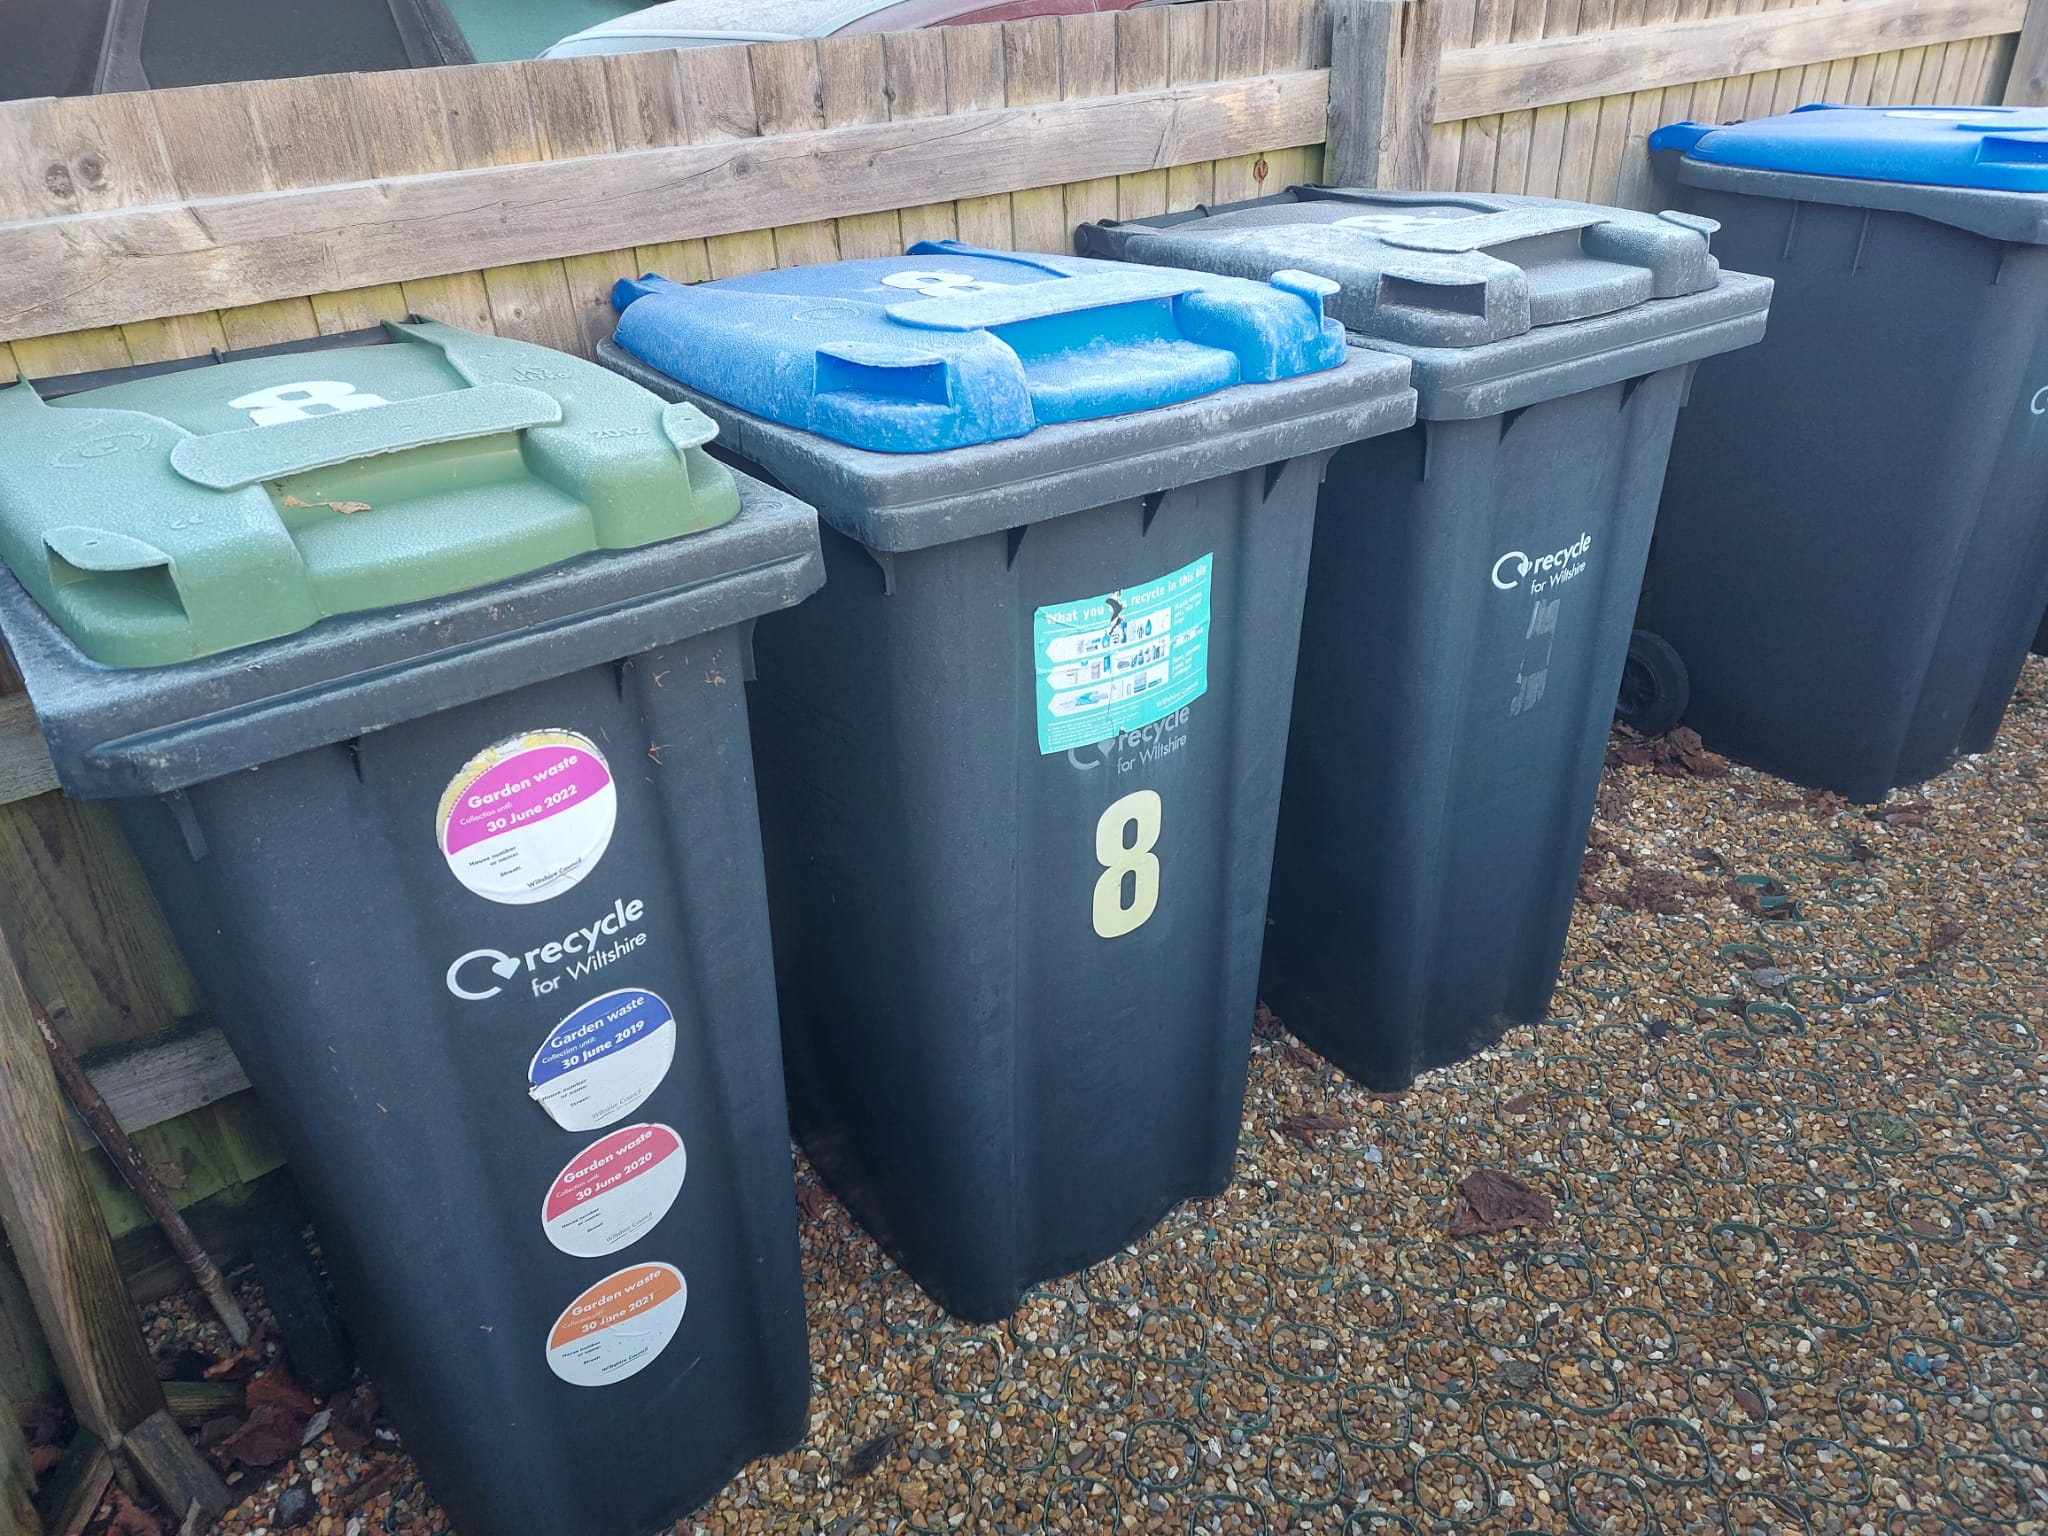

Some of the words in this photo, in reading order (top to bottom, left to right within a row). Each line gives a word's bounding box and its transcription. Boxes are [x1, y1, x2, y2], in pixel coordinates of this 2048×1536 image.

[881, 271, 1000, 298] 8
[227, 381, 391, 427] 8
[1533, 532, 1592, 574] recycle
[1045, 610, 1078, 625] What
[1083, 606, 1104, 620] you
[1131, 585, 1165, 606] recycle
[1167, 580, 1176, 592] in
[1178, 572, 1193, 587] this
[1195, 565, 1207, 578] bin
[1530, 579, 1547, 595] for
[1550, 561, 1586, 588] Wiltshire
[1118, 705, 1191, 751] recycle
[1116, 756, 1135, 774] for
[1139, 733, 1187, 762] Wiltshire
[467, 779, 531, 809] Garden
[533, 754, 578, 783] waste
[460, 810, 496, 826] Collection
[487, 819, 507, 833] 30
[509, 804, 543, 826] June
[544, 784, 578, 809] 2022
[527, 871, 558, 888] Wiltshire
[559, 857, 582, 873] Council
[1092, 789, 1162, 939] 8
[524, 898, 644, 972] recycle
[531, 976, 561, 998] for
[565, 932, 648, 981] Wiltshire
[551, 1018, 604, 1049] Garden
[606, 996, 645, 1022] waste
[562, 1055, 580, 1070] 30
[582, 1039, 612, 1062] June
[615, 1020, 645, 1045] 2019
[542, 1046, 578, 1064] Collection
[563, 1155, 614, 1184] Garden
[615, 1130, 652, 1156] waste
[575, 1187, 592, 1201] 30
[594, 1172, 622, 1192] June
[624, 1152, 653, 1176] 2020
[572, 1290, 622, 1316] Garden
[624, 1270, 661, 1294] waste
[581, 1320, 597, 1333] 30
[600, 1309, 627, 1327] June
[628, 1292, 655, 1312] 2021
